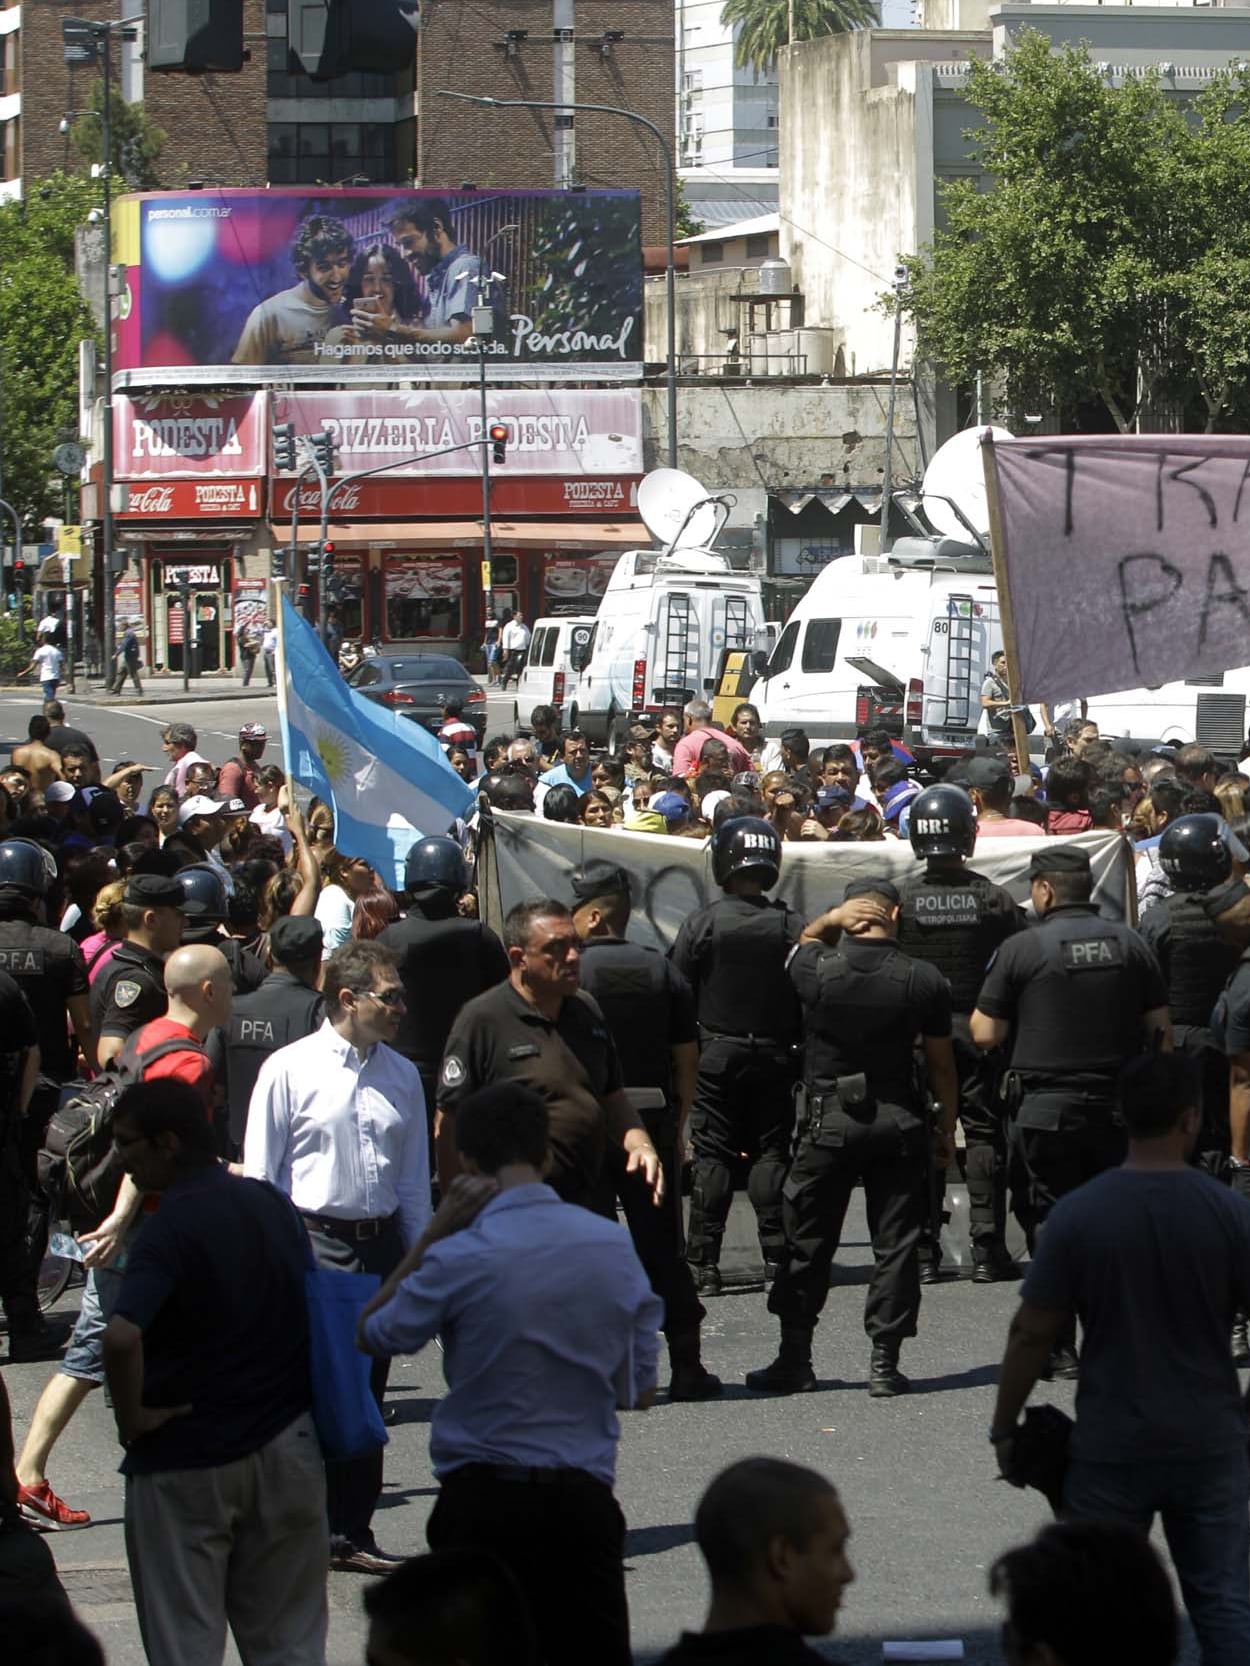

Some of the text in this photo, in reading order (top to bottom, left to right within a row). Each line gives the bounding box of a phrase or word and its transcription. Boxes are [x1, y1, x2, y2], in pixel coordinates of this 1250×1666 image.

[509, 313, 634, 359] Personal
[313, 341, 382, 359] Hagamos
[385, 344, 415, 359] que
[416, 341, 451, 356] todo
[131, 416, 243, 457] PODESTA
[320, 417, 456, 453] PIZZERIA
[194, 484, 246, 503] PODESTA
[563, 481, 625, 500] PODESTA
[165, 564, 220, 584] POESTA
[934, 622, 948, 634] 80
[743, 833, 776, 850] BRI
[915, 893, 978, 912] POLICIA
[1071, 941, 1113, 965] PFA
[240, 1019, 275, 1043] PFA
